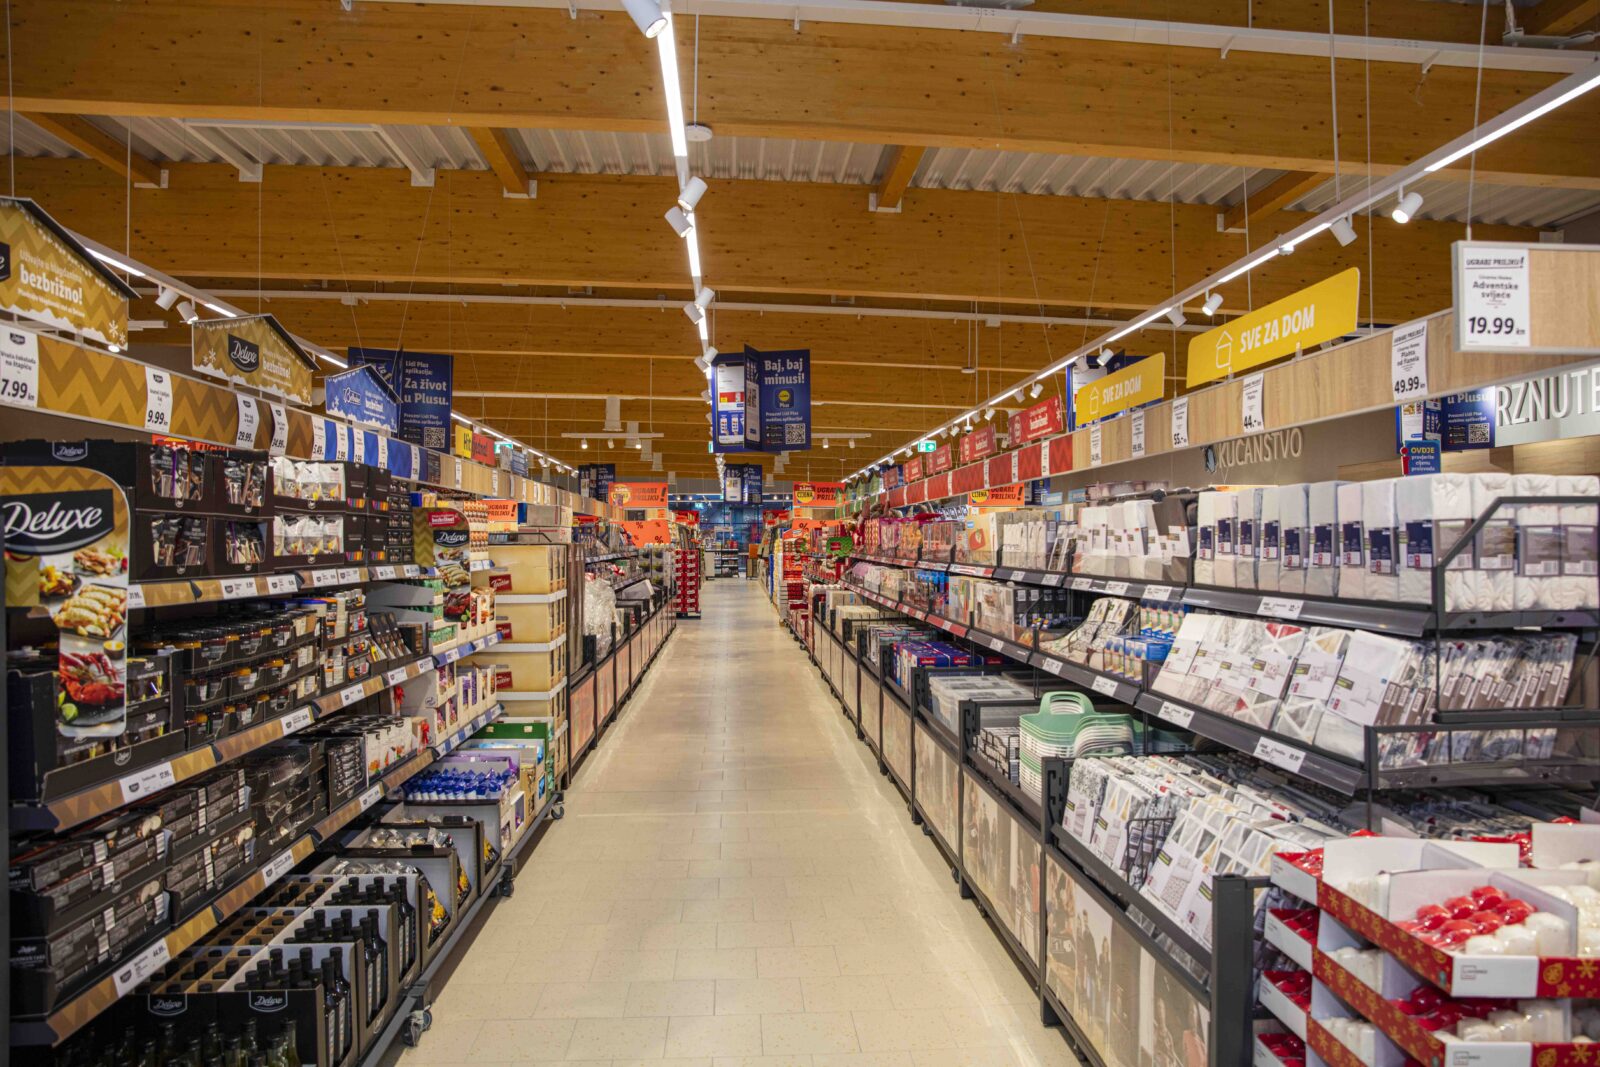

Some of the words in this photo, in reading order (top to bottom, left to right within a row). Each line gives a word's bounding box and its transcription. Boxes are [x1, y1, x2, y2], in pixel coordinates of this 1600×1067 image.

[20, 263, 83, 305] bezbrižno!
[1473, 281, 1518, 290] Adventske
[1240, 329, 1261, 353] SVE
[1263, 321, 1280, 345] ZA
[1282, 304, 1315, 335] DOM
[1468, 316, 1514, 334] 19.99
[230, 340, 257, 364] Deluxe
[764, 360, 784, 372] Baj,
[786, 358, 803, 372] baj
[405, 377, 418, 389] Za
[420, 378, 447, 391] život
[764, 373, 805, 385] minusi!
[1395, 376, 1420, 394] 49.99
[1, 378, 28, 399] 7.99
[1102, 385, 1114, 405] SVE
[1114, 381, 1124, 401] ZA
[1124, 375, 1141, 397] DOM
[404, 394, 411, 403] u
[414, 392, 449, 406] Plusu.
[147, 410, 165, 425] 9.99
[57, 446, 84, 456] Deluxe
[2, 501, 103, 540] Deluxe
[436, 532, 466, 544] Deluxe
[153, 1000, 182, 1010] Deluxe
[255, 996, 283, 1006] Deluxe
